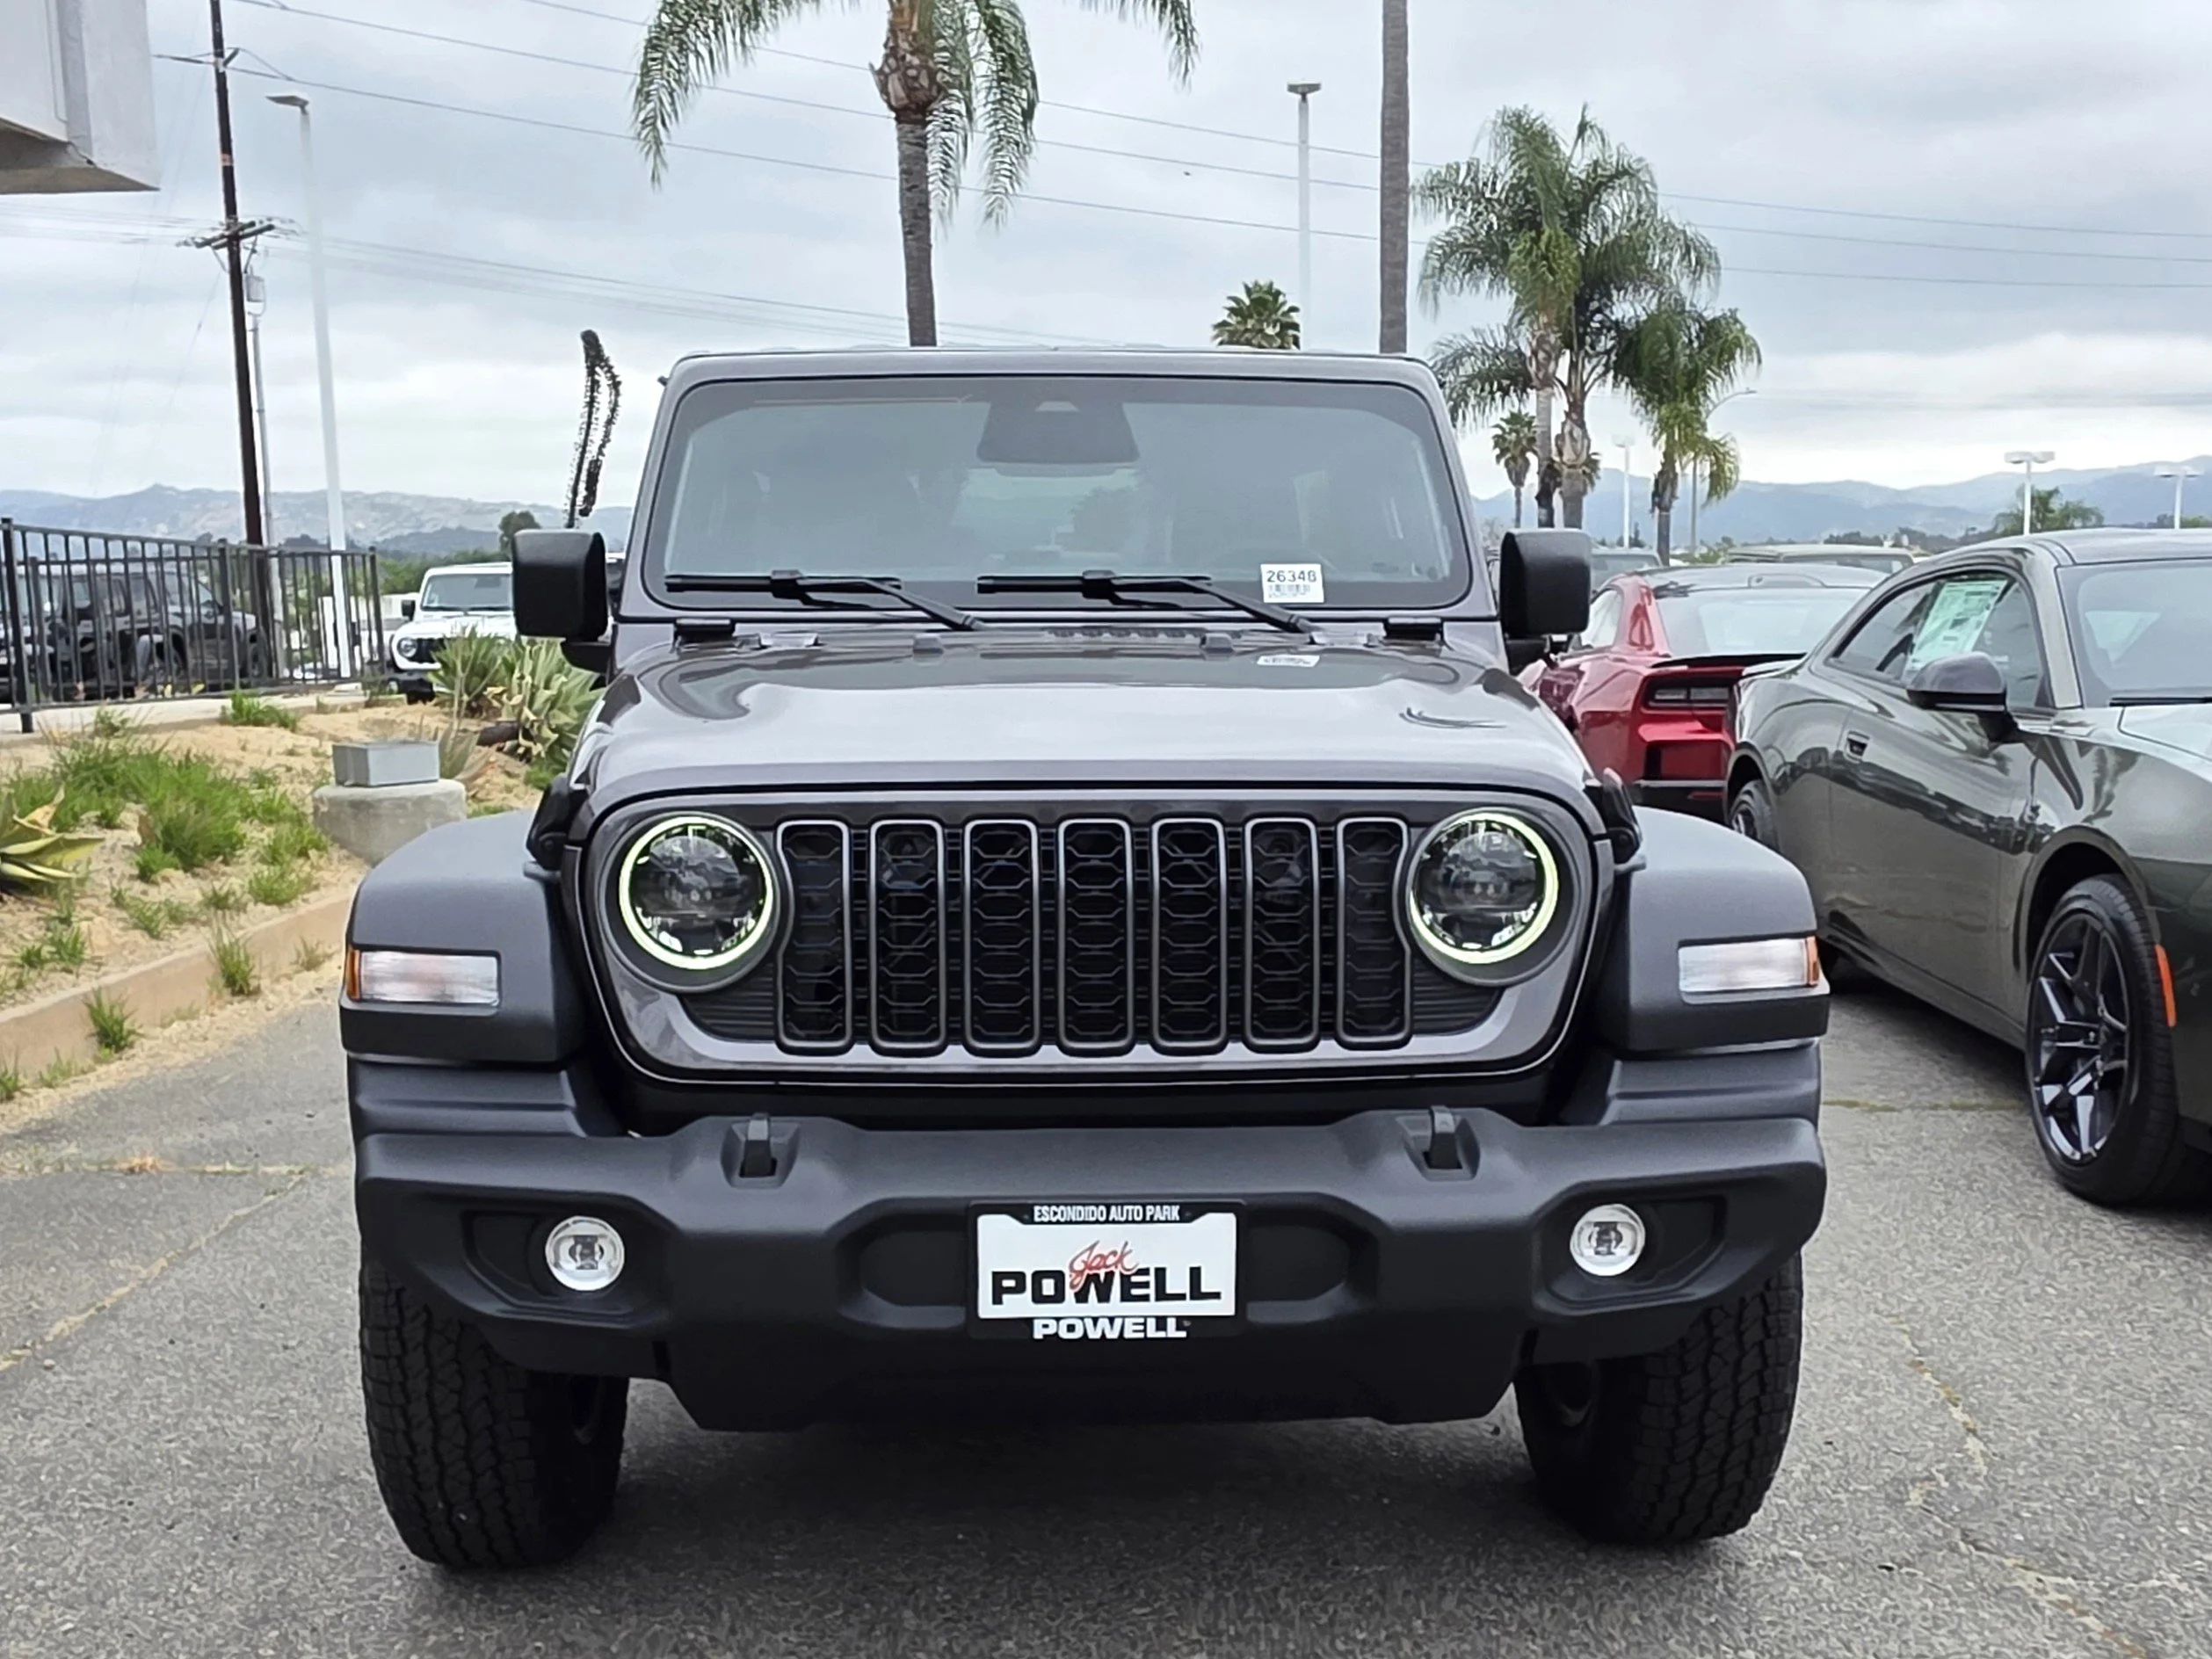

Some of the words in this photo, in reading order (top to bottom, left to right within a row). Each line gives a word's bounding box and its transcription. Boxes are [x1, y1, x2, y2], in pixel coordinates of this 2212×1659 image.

[1033, 1206, 1106, 1222] ESCONDIDO
[1108, 1205, 1142, 1221] AUTO
[1145, 1205, 1180, 1221] PARK
[1069, 1240, 1139, 1290] Jack
[991, 1265, 1222, 1306] POWELL
[1033, 1317, 1187, 1340] POWELL
